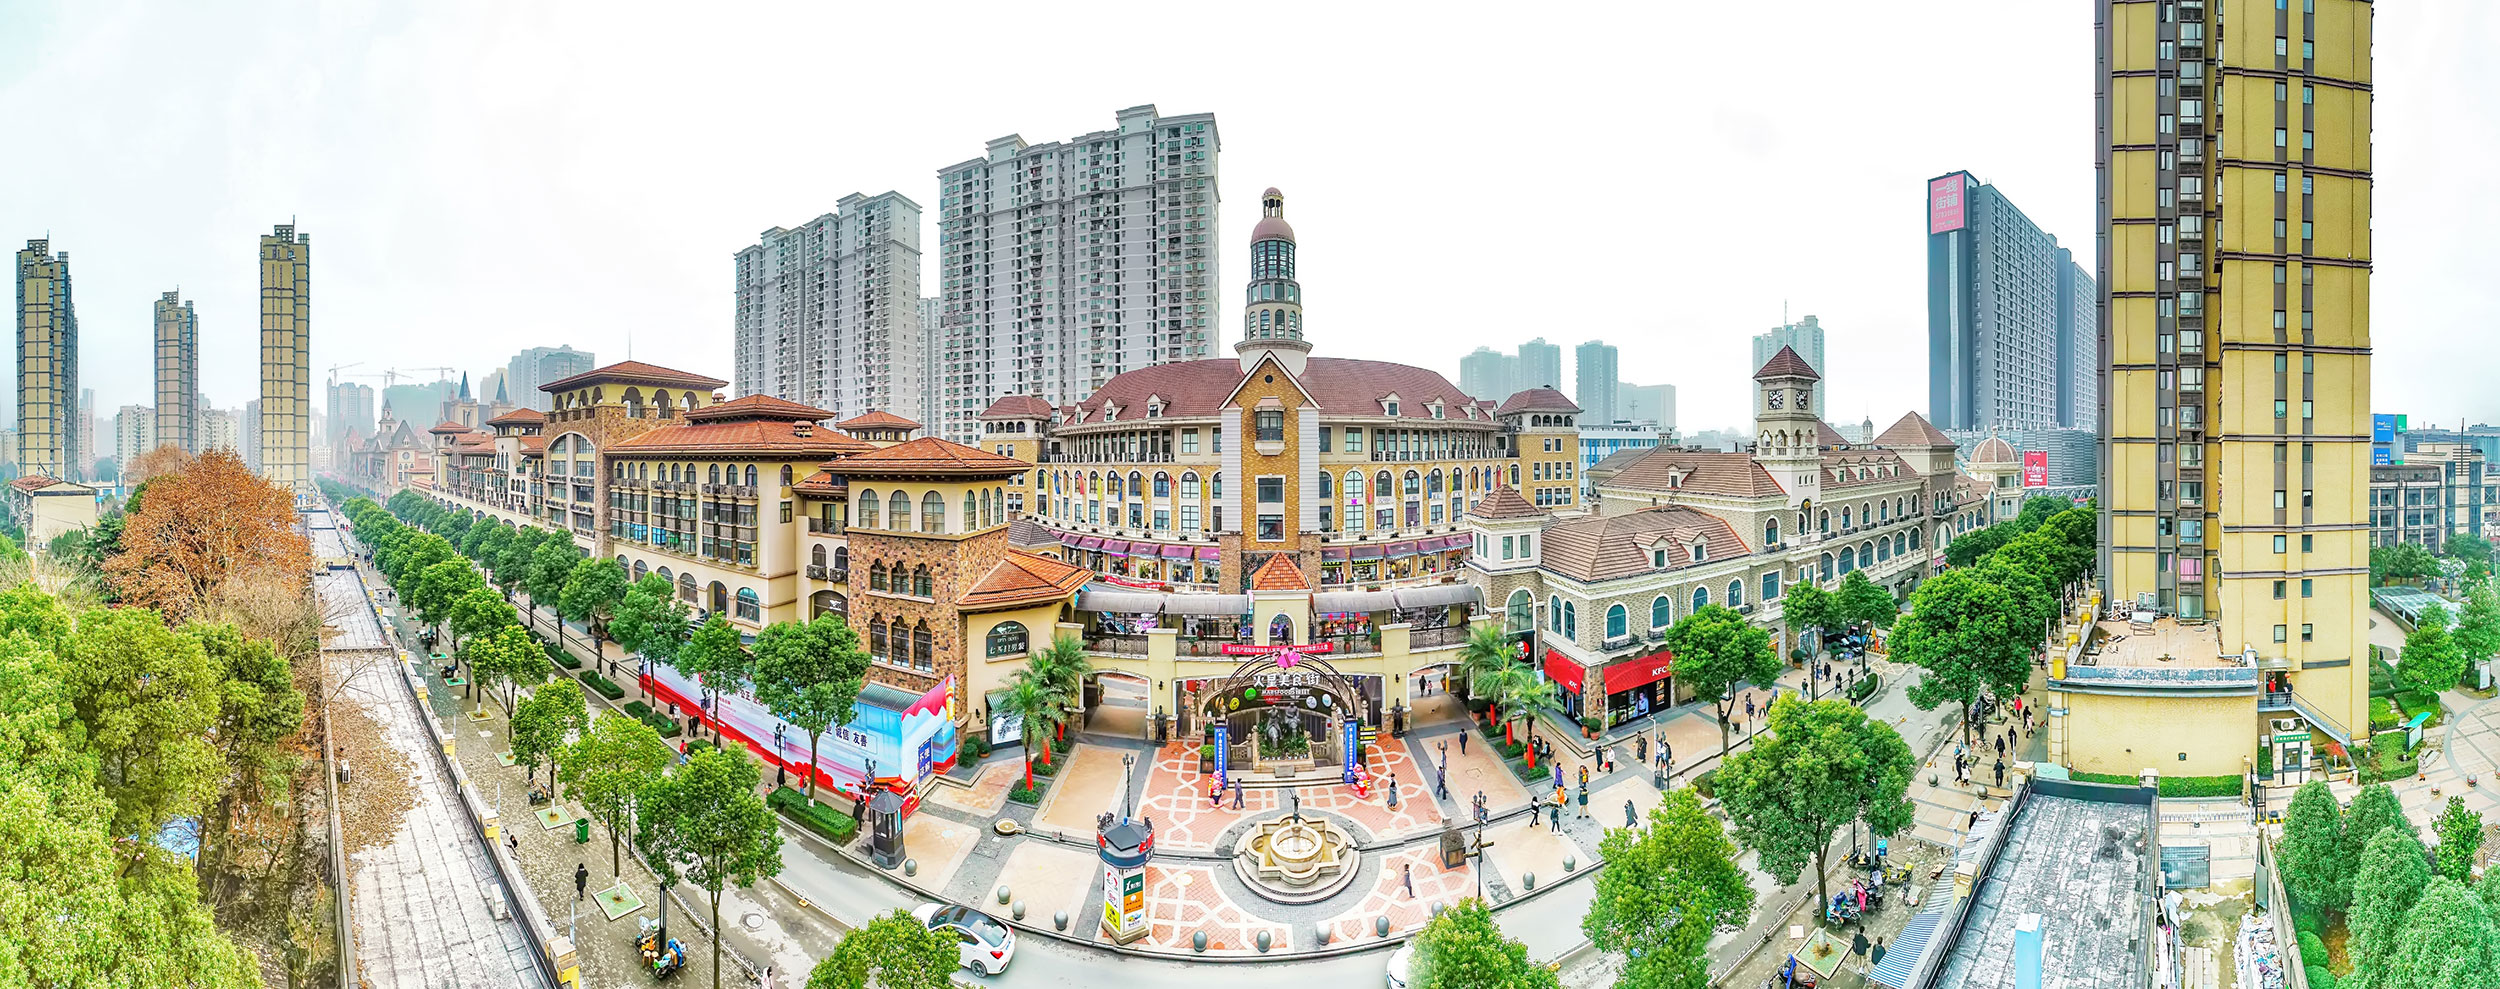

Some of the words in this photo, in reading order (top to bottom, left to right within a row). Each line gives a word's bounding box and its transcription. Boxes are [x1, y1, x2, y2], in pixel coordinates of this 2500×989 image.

[1651, 666, 1667, 677] KFC
[1253, 671, 1321, 687] 火星美食街
[1568, 680, 1577, 689] KFC
[835, 725, 849, 741] 诚信
[853, 732, 868, 748] 友善
